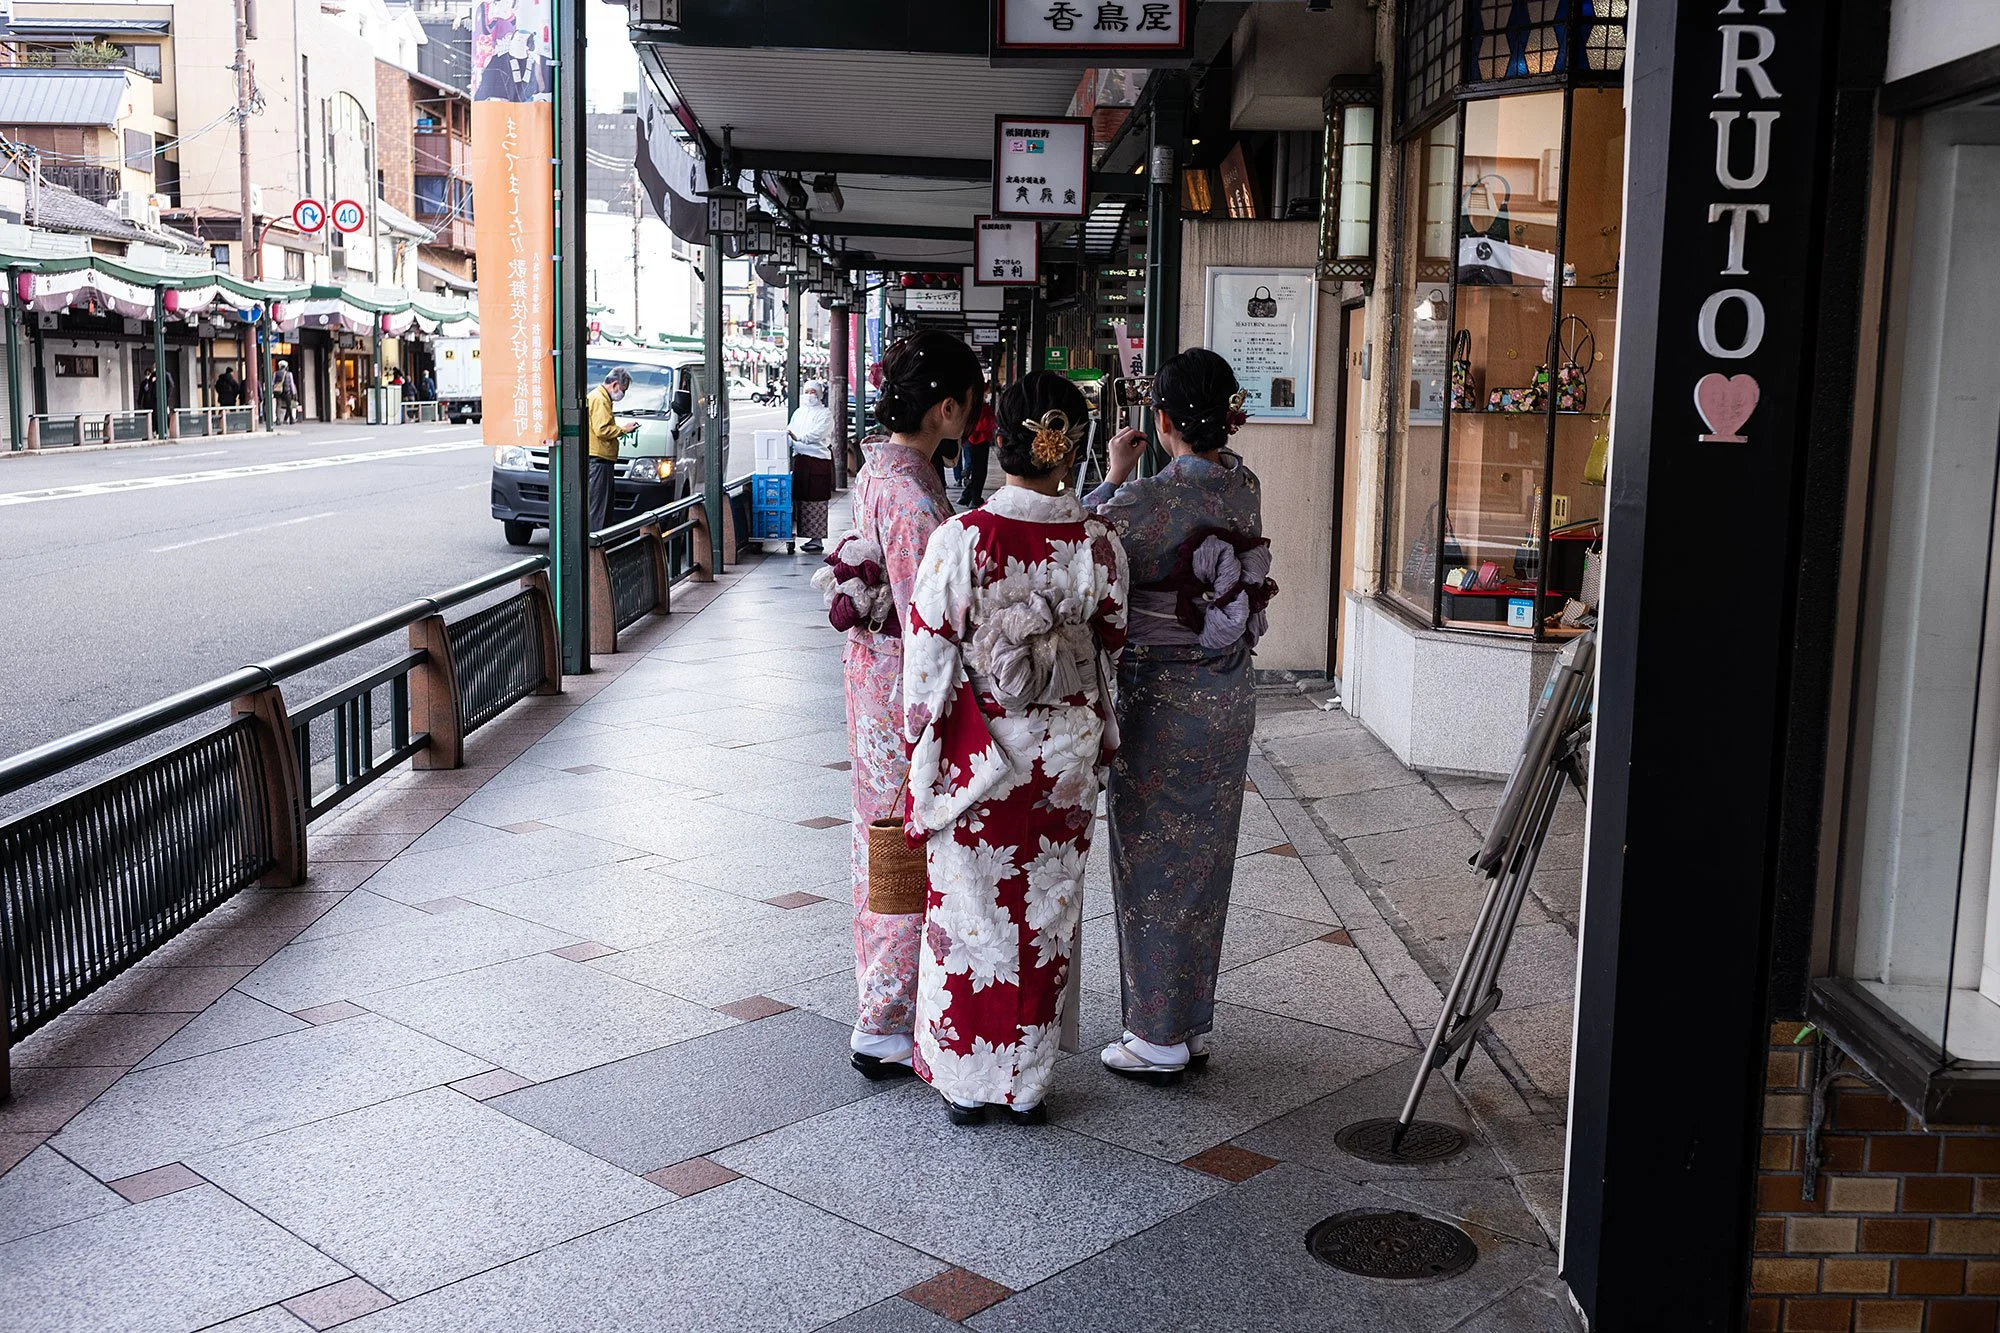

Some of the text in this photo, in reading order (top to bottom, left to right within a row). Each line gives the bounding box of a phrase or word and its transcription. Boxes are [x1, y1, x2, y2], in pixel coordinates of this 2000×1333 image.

[1043, 1, 1173, 32] 香鳥屋
[1697, 0, 1787, 360] RUTO
[339, 209, 357, 223] 40
[992, 265, 1023, 278] 西利
